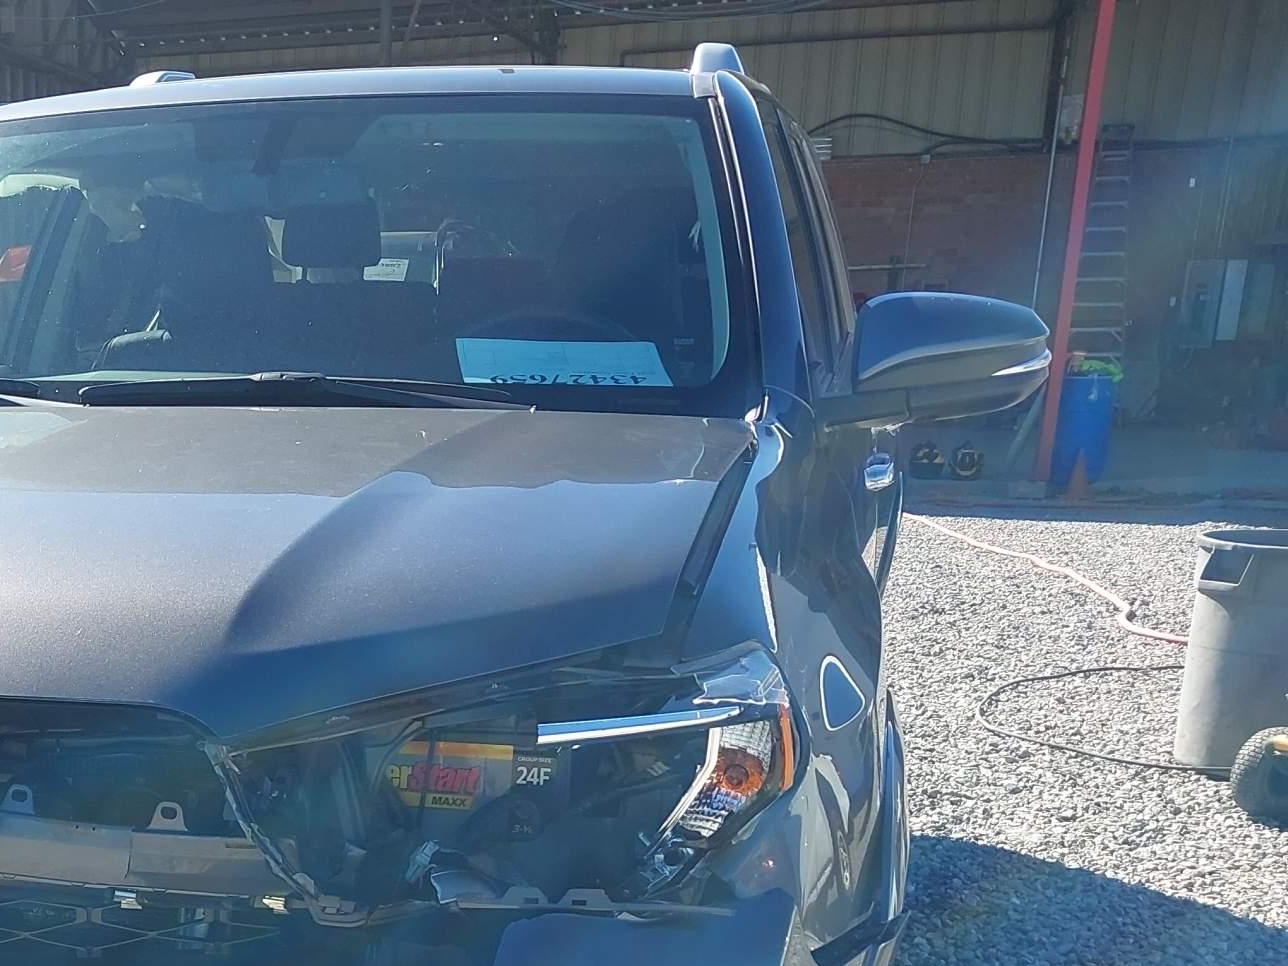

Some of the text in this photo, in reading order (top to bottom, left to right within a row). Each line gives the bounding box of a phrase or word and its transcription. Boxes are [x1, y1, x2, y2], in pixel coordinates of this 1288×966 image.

[386, 762, 481, 793] erStart
[515, 766, 551, 786] 24F
[431, 796, 466, 807] MAXX
